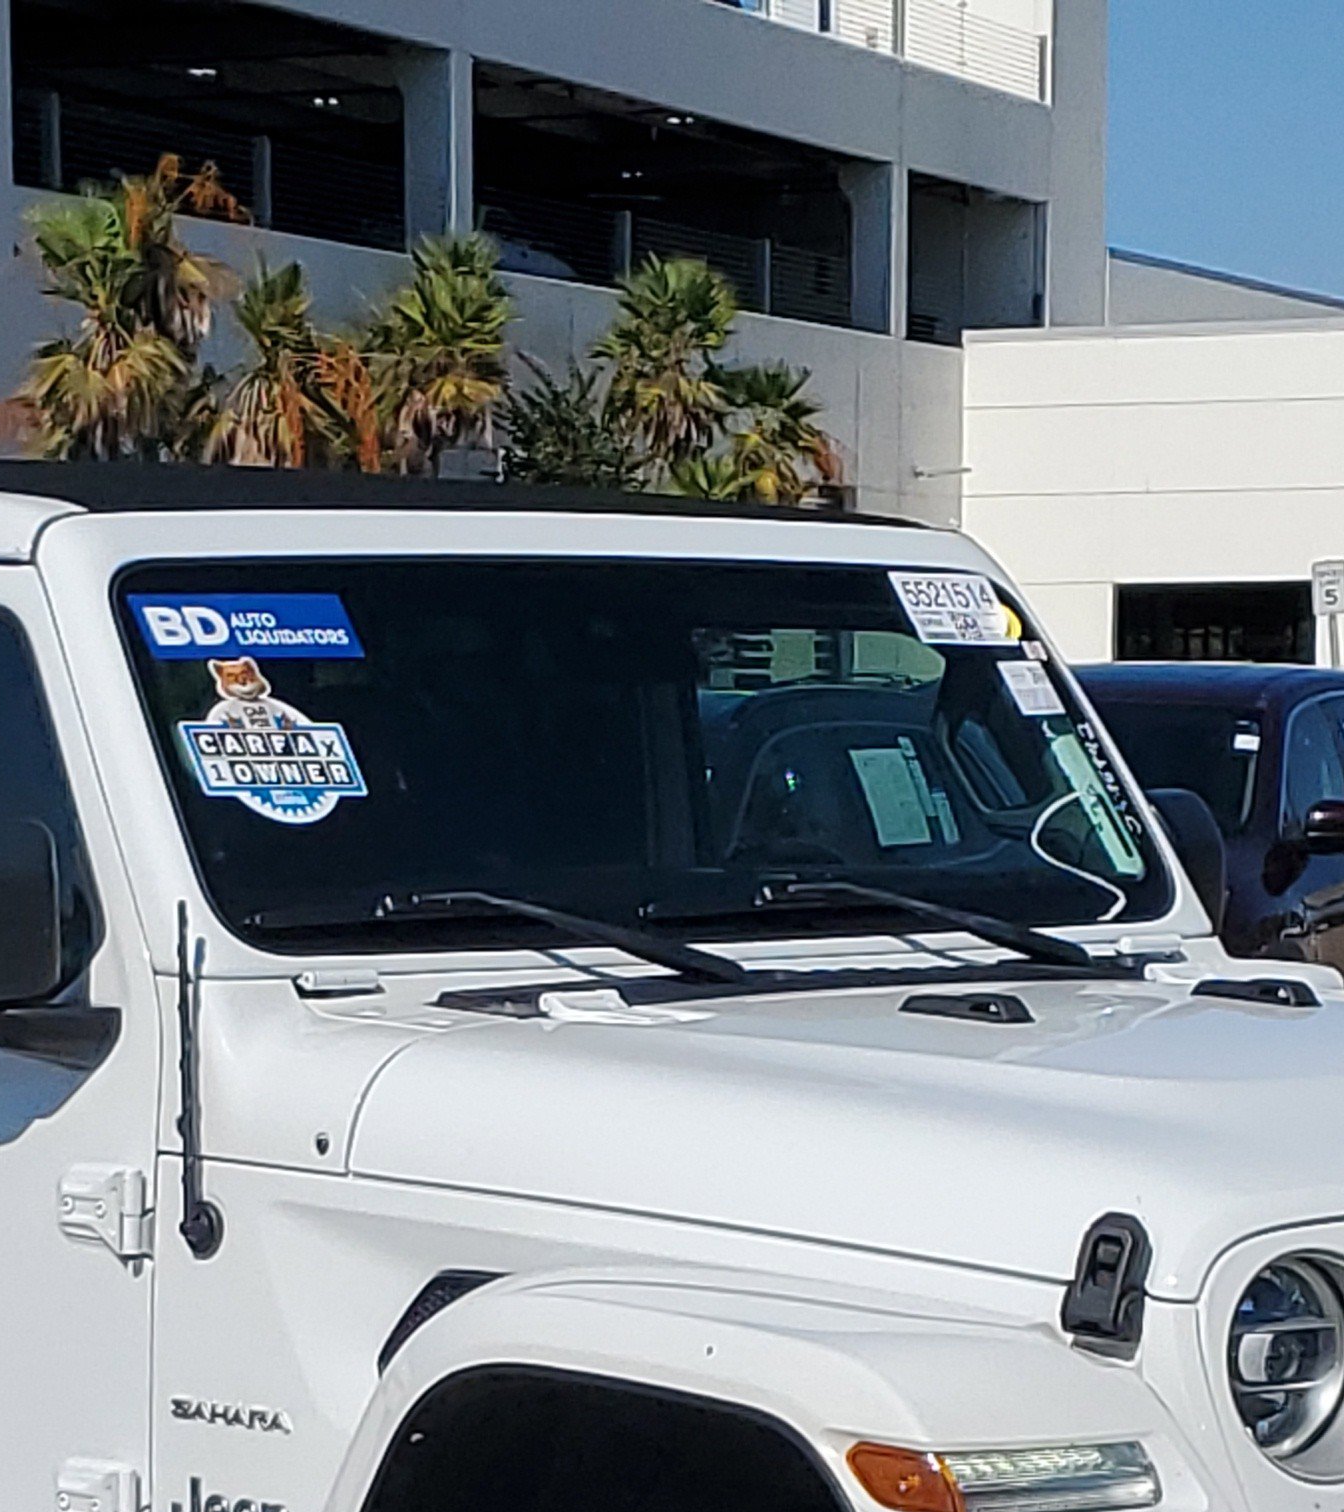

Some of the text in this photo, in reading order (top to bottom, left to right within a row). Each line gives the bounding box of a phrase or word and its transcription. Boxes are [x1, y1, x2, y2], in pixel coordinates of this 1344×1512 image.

[901, 580, 994, 609] 5521514
[1324, 588, 1338, 606] 5
[142, 606, 230, 646] BD
[230, 612, 276, 628] AUTO
[234, 629, 350, 645] LIQUIDATORS
[197, 734, 341, 757] CARFAX
[211, 763, 350, 784] 1 OWNER
[170, 1398, 292, 1435] SAHARA
